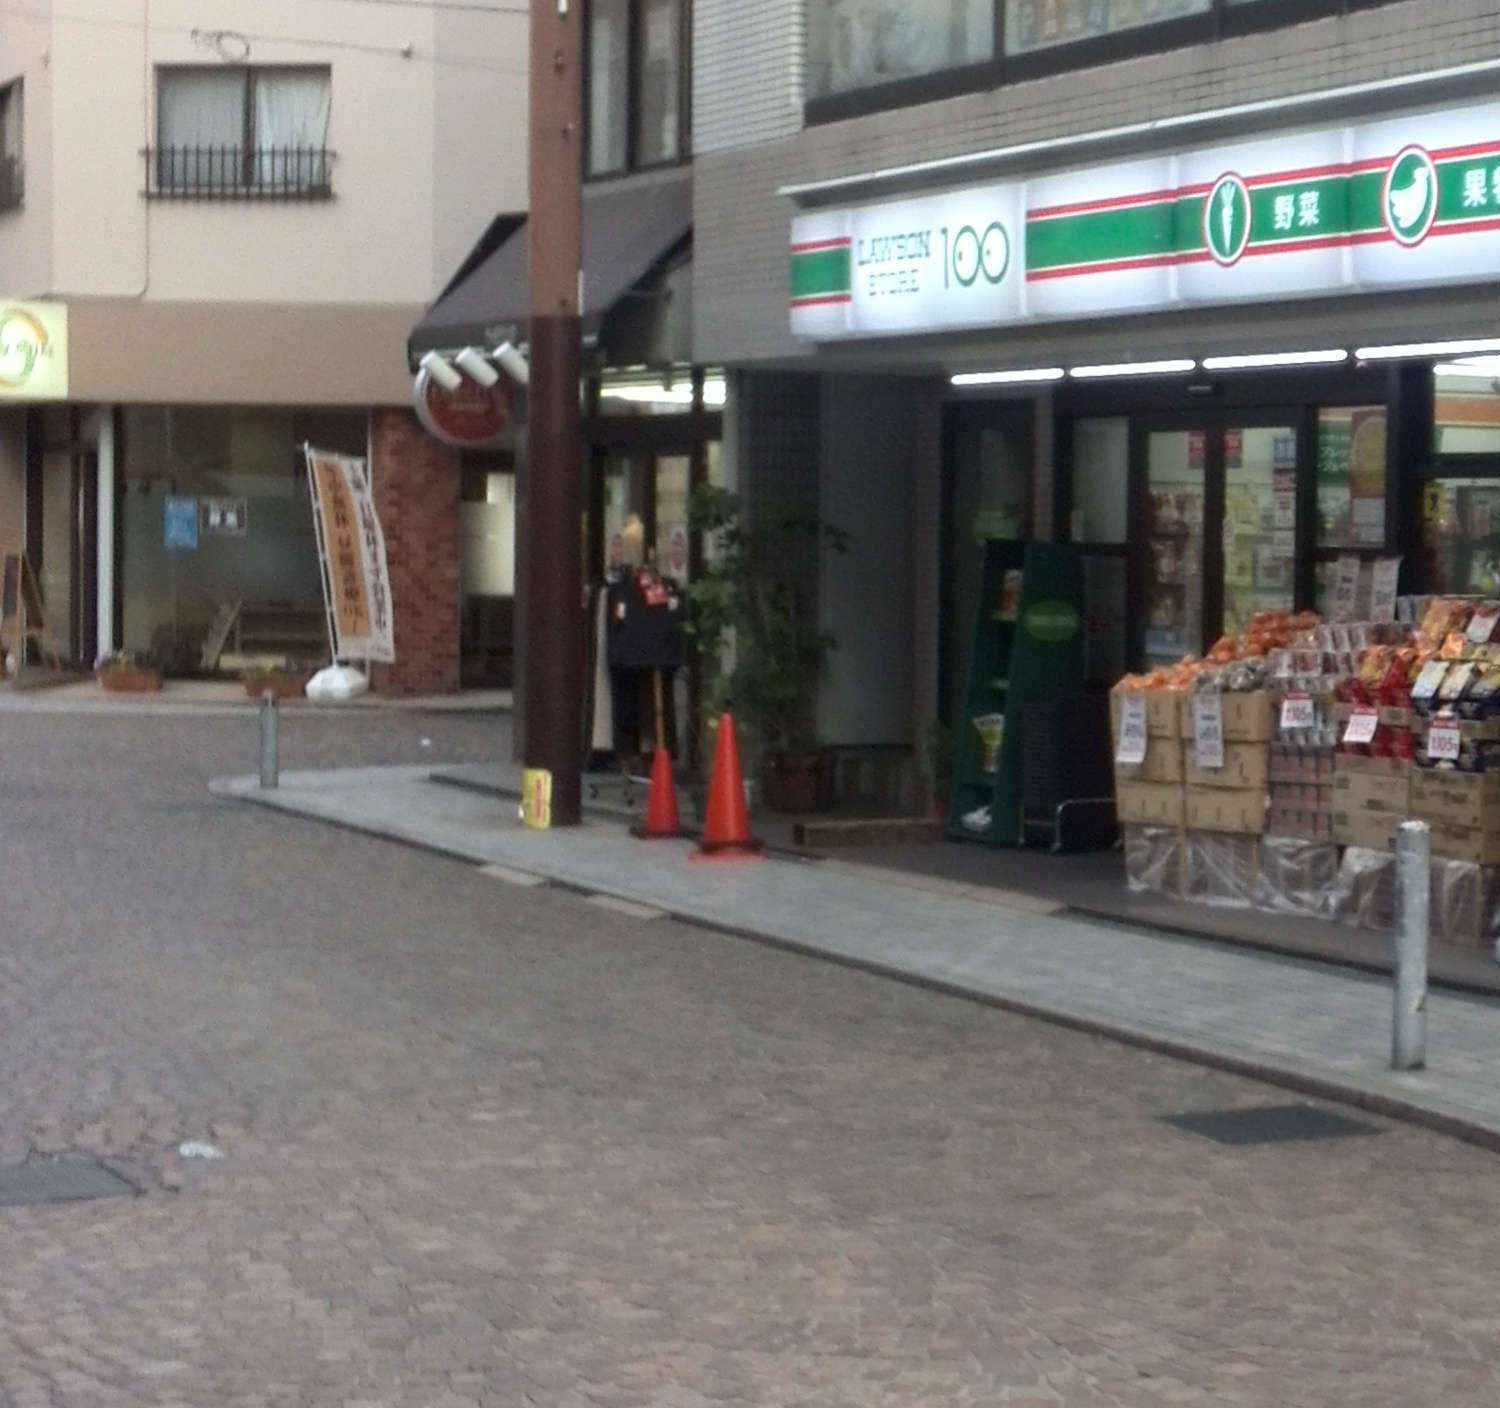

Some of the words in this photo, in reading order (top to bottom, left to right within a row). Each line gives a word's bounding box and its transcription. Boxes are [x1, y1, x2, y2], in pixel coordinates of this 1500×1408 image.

[1272, 190, 1321, 231] 野菜
[857, 229, 932, 266] LAWSON
[939, 220, 1010, 291] 100
